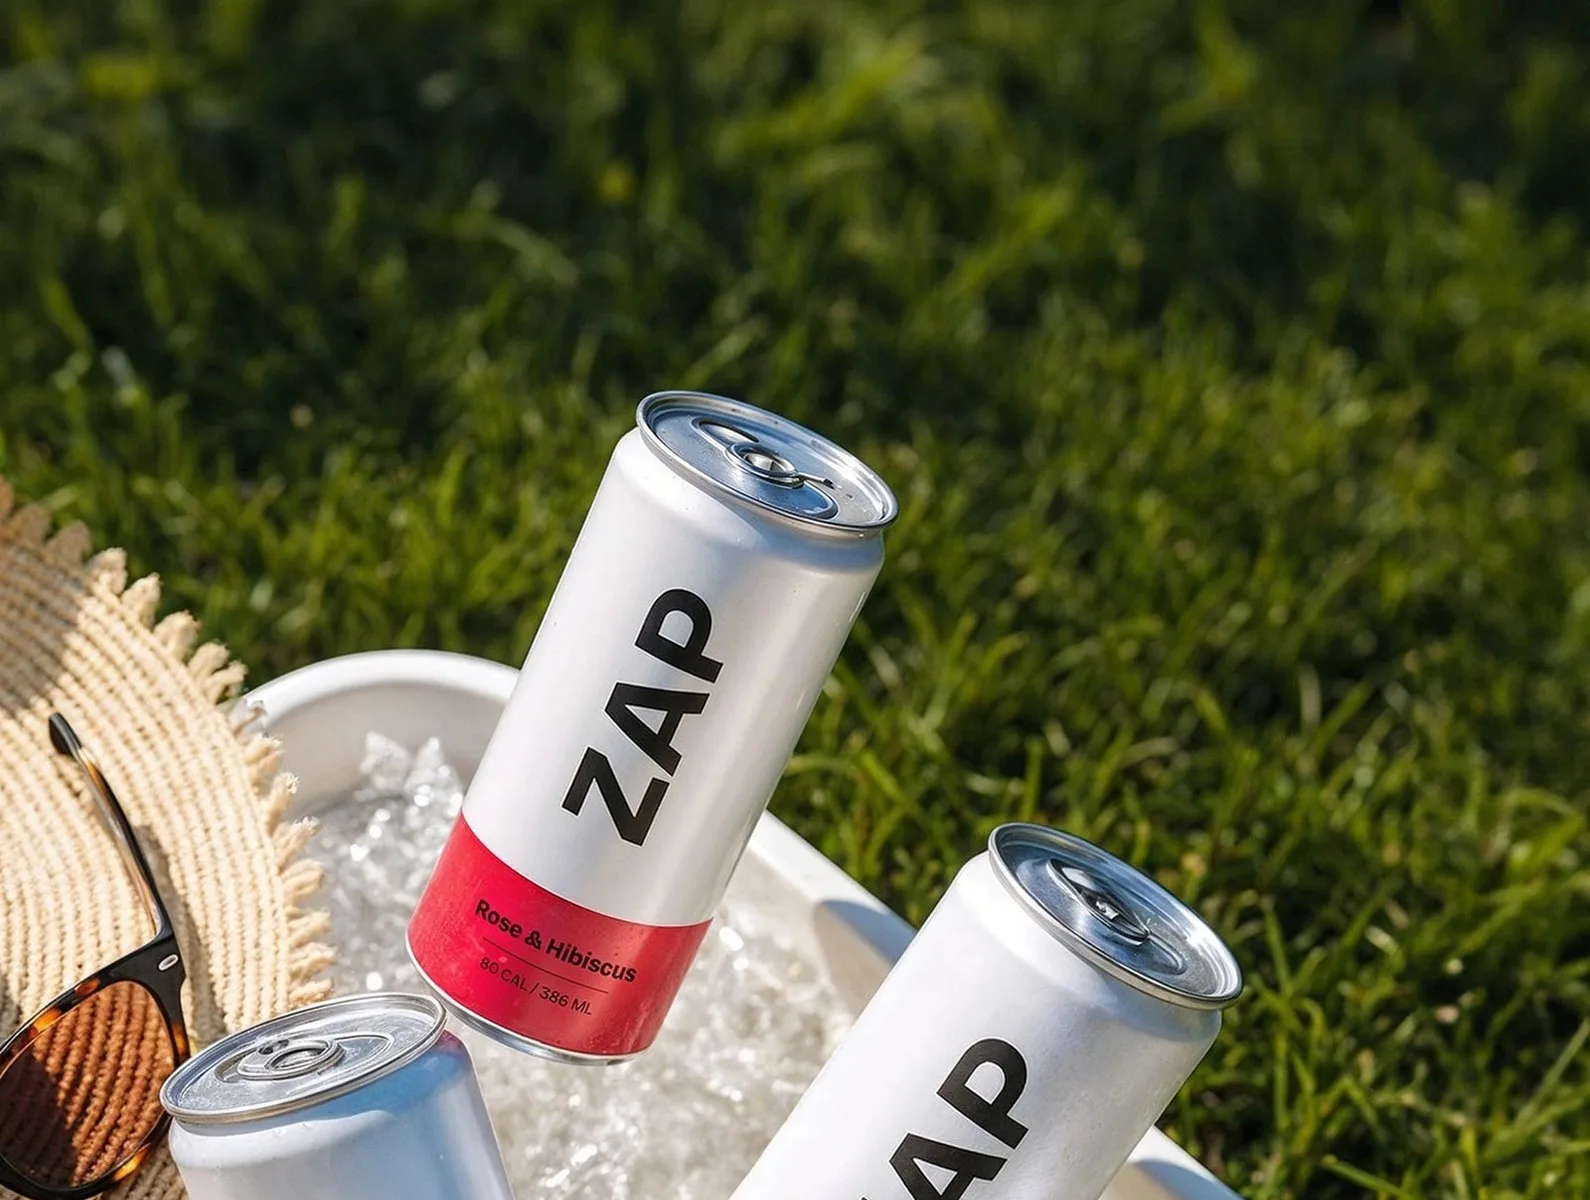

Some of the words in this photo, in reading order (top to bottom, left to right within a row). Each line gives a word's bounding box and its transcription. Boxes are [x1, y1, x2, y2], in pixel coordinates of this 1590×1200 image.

[562, 587, 725, 847] ZAP
[474, 898, 523, 939] Rose
[524, 930, 543, 950] &
[545, 938, 637, 983] Hibiscus
[479, 956, 499, 975] 80
[499, 967, 528, 991] CAL
[528, 982, 539, 995] /
[539, 987, 568, 1008] 386
[571, 997, 592, 1016] ML
